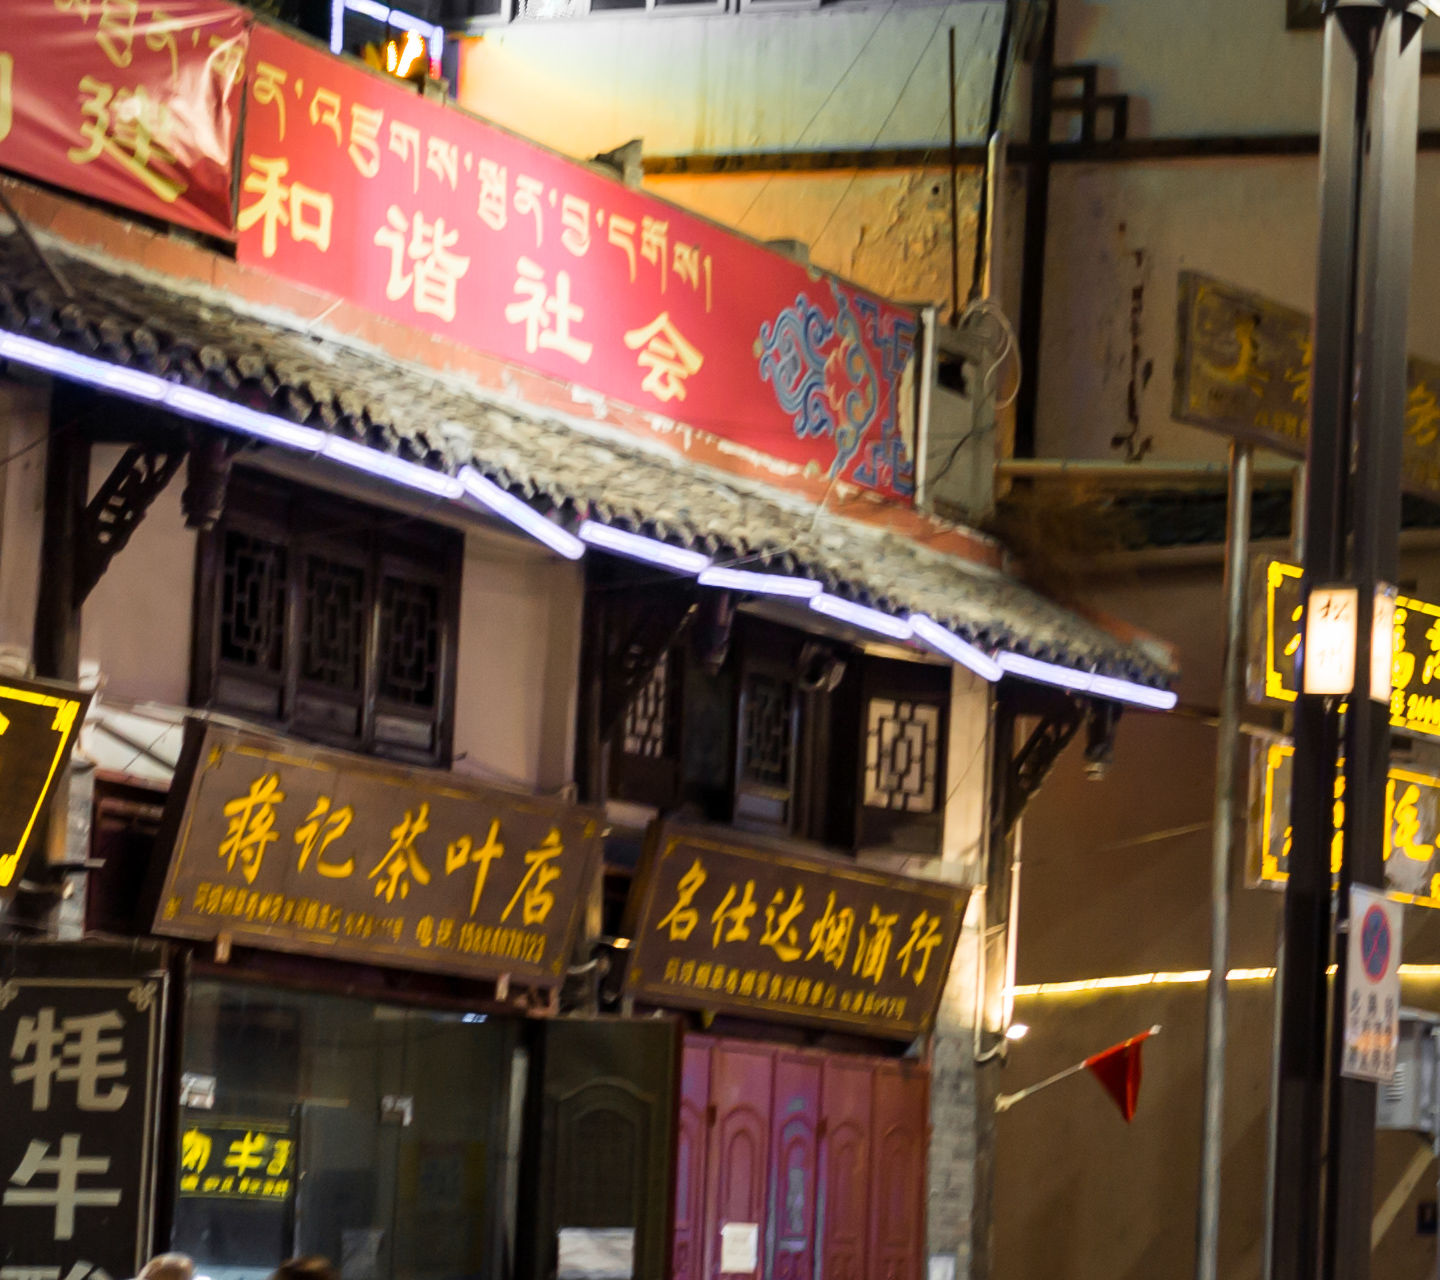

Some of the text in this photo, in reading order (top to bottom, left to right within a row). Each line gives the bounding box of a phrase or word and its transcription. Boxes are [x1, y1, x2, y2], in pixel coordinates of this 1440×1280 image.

[0, 51, 704, 403] 建和谐社会
[218, 773, 563, 926] 蒋记茶叶店
[657, 858, 942, 986] 名仕达烟酒行
